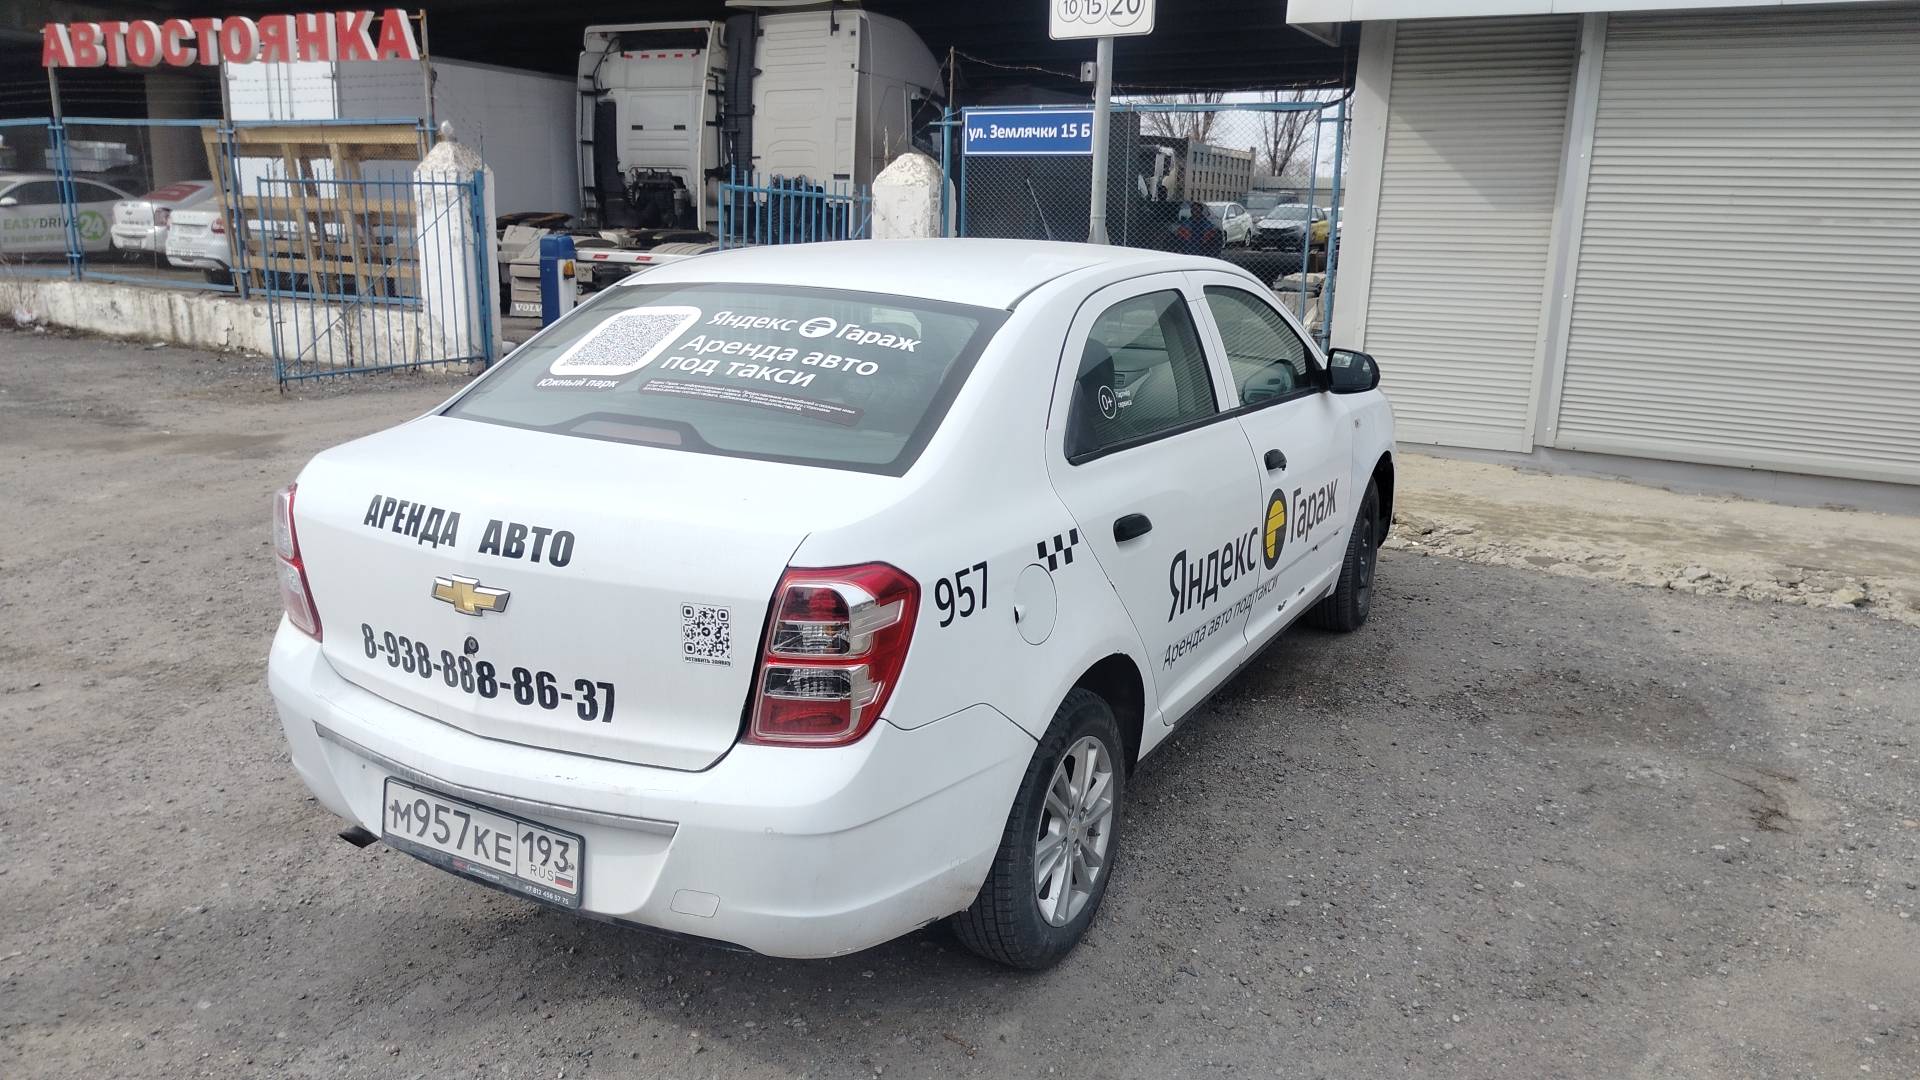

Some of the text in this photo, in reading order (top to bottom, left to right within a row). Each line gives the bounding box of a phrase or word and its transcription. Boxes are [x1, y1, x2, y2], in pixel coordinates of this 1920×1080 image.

[1064, 0, 1077, 15] 10
[1085, 0, 1102, 15] 15
[1110, 0, 1141, 16] 20
[42, 9, 420, 68] АВТОСТОЯНКА
[968, 123, 1091, 142] ул. Землячки 15 Б
[514, 303, 542, 313] VOLV
[705, 311, 922, 352] Яндекс Гараж
[660, 356, 817, 388] под такси
[679, 335, 879, 376] Аренда авто
[536, 377, 620, 389] Южный парк
[364, 494, 576, 568] АРЕНДА АВТО
[1168, 478, 1339, 624] Яндекс Гараж
[934, 560, 988, 629] 957
[1162, 630, 1207, 672] Аренда
[1206, 608, 1234, 638] авто
[361, 623, 616, 724] 8-938-888-86-37
[393, 798, 572, 874] М957КЕ 193
[529, 863, 555, 882] RUS
